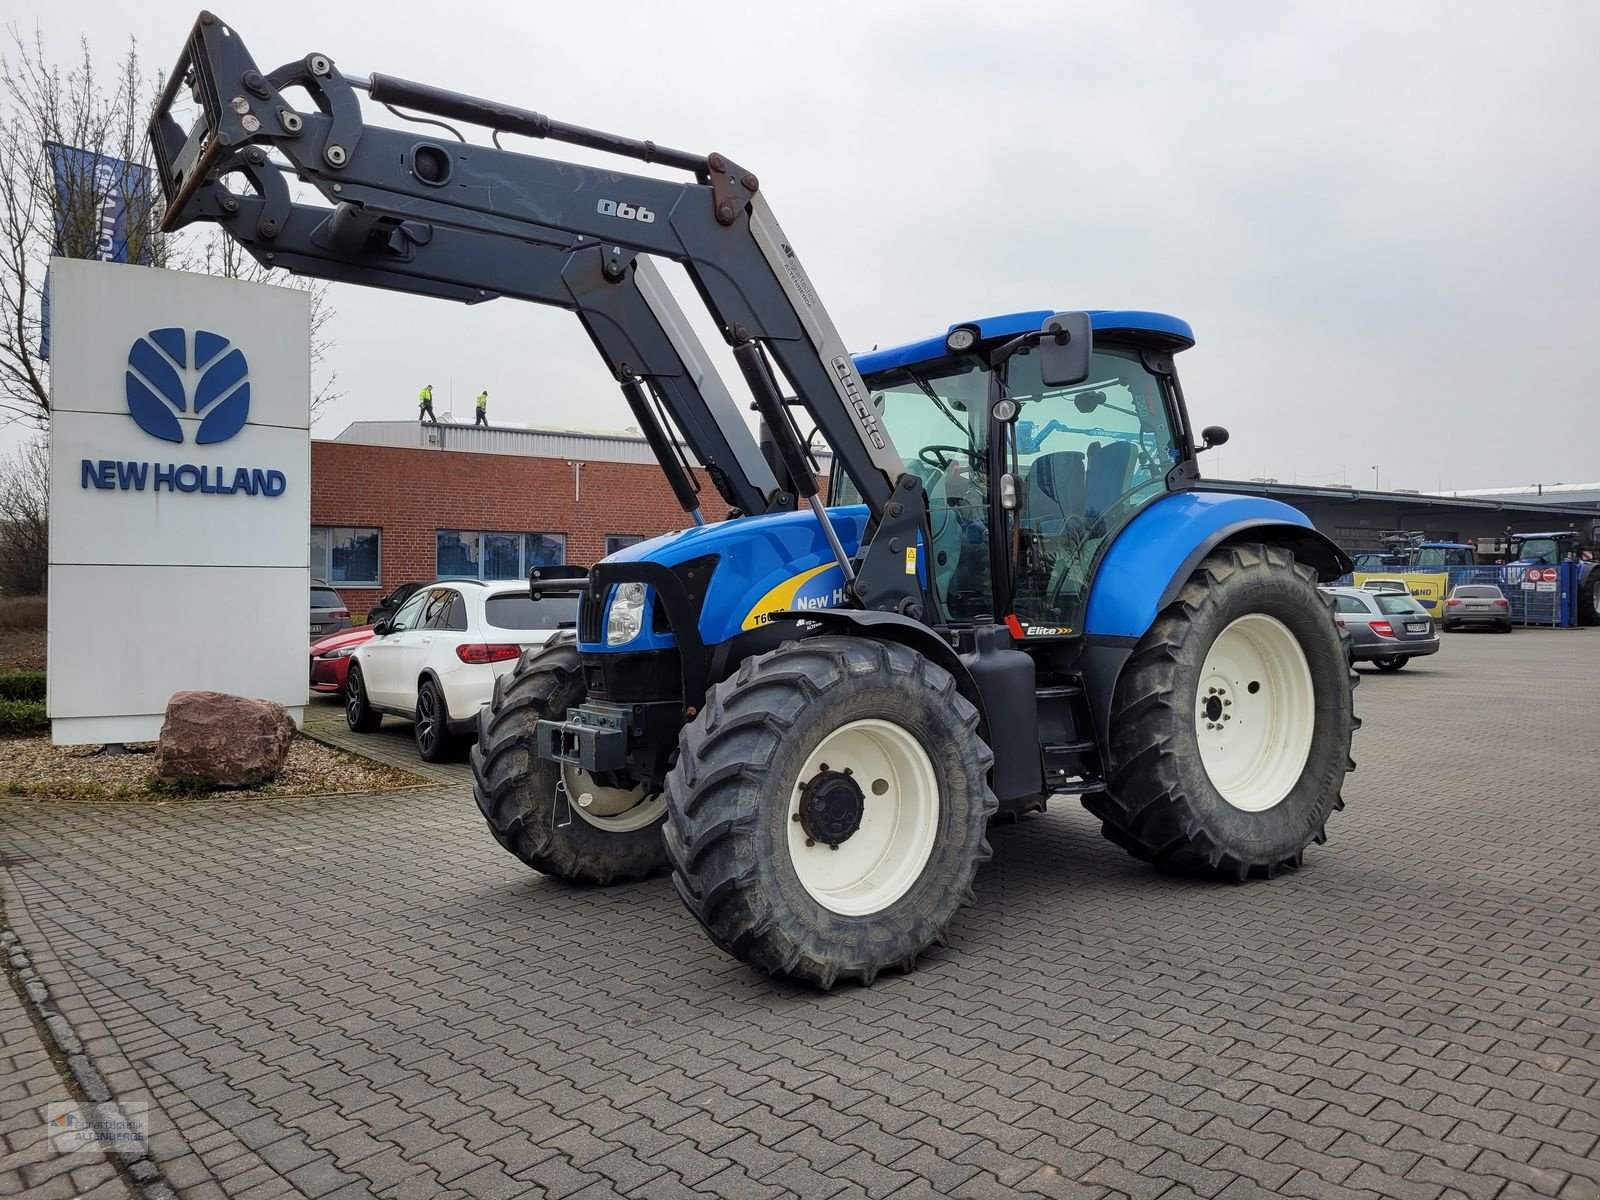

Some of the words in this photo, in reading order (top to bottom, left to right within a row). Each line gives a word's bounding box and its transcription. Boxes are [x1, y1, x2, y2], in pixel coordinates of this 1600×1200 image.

[81, 459, 149, 490] NEW
[154, 463, 287, 497] HOLLAND
[797, 595, 829, 610] New
[1027, 626, 1057, 636] Elite
